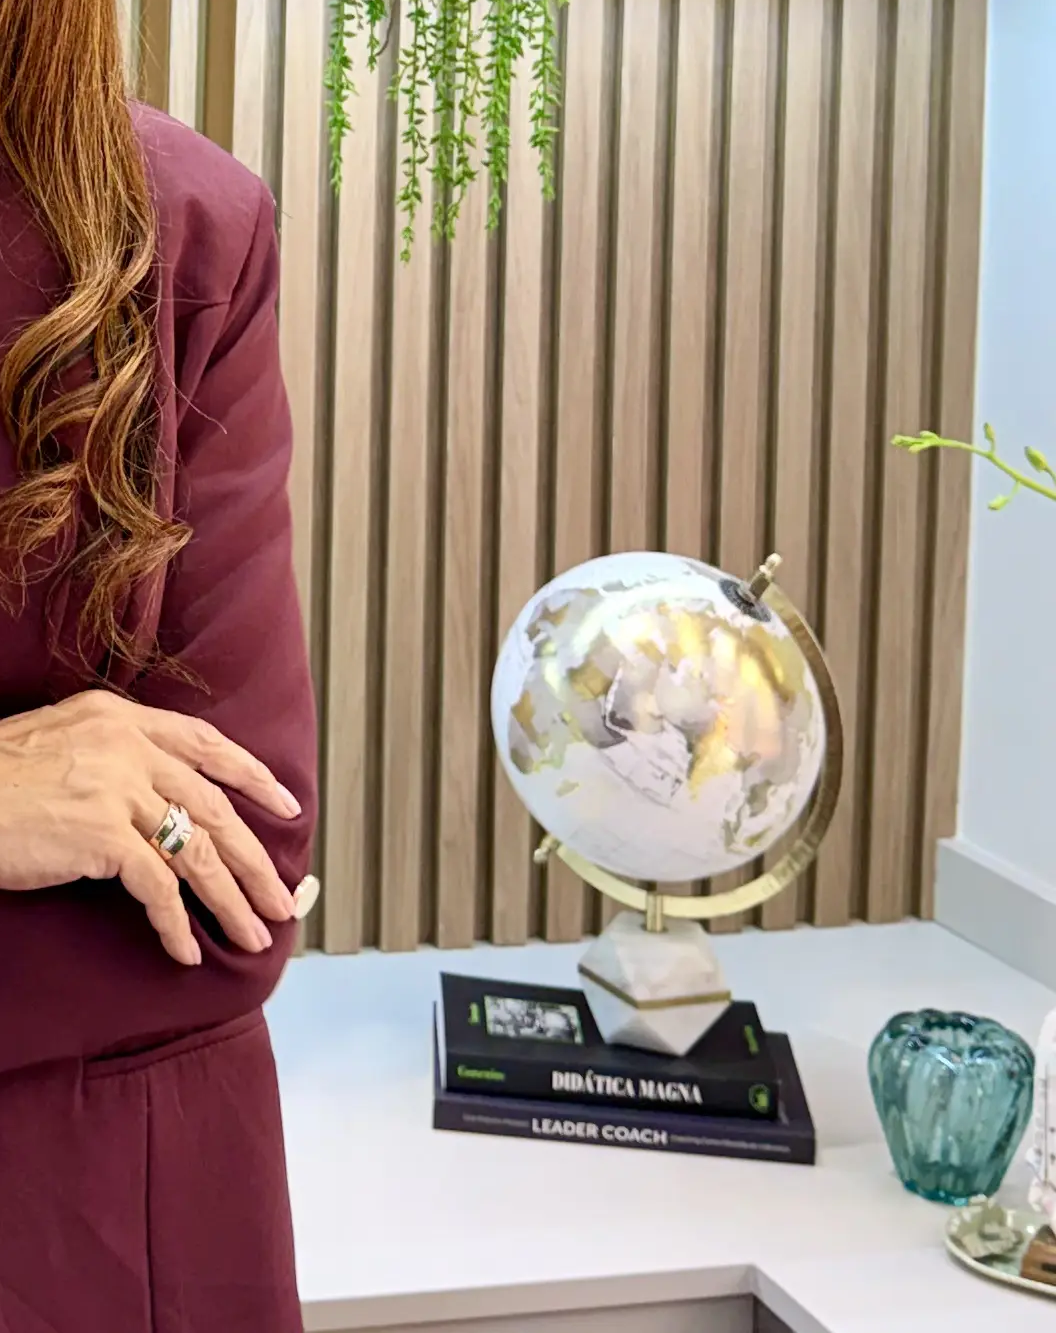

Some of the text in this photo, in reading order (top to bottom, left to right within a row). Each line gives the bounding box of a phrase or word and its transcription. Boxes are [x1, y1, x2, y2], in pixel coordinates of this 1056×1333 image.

[551, 1069, 635, 1098] DIDÁTICA
[639, 1079, 703, 1106] MAGNA
[532, 1118, 598, 1139] LEADER
[602, 1125, 669, 1146] COACH
